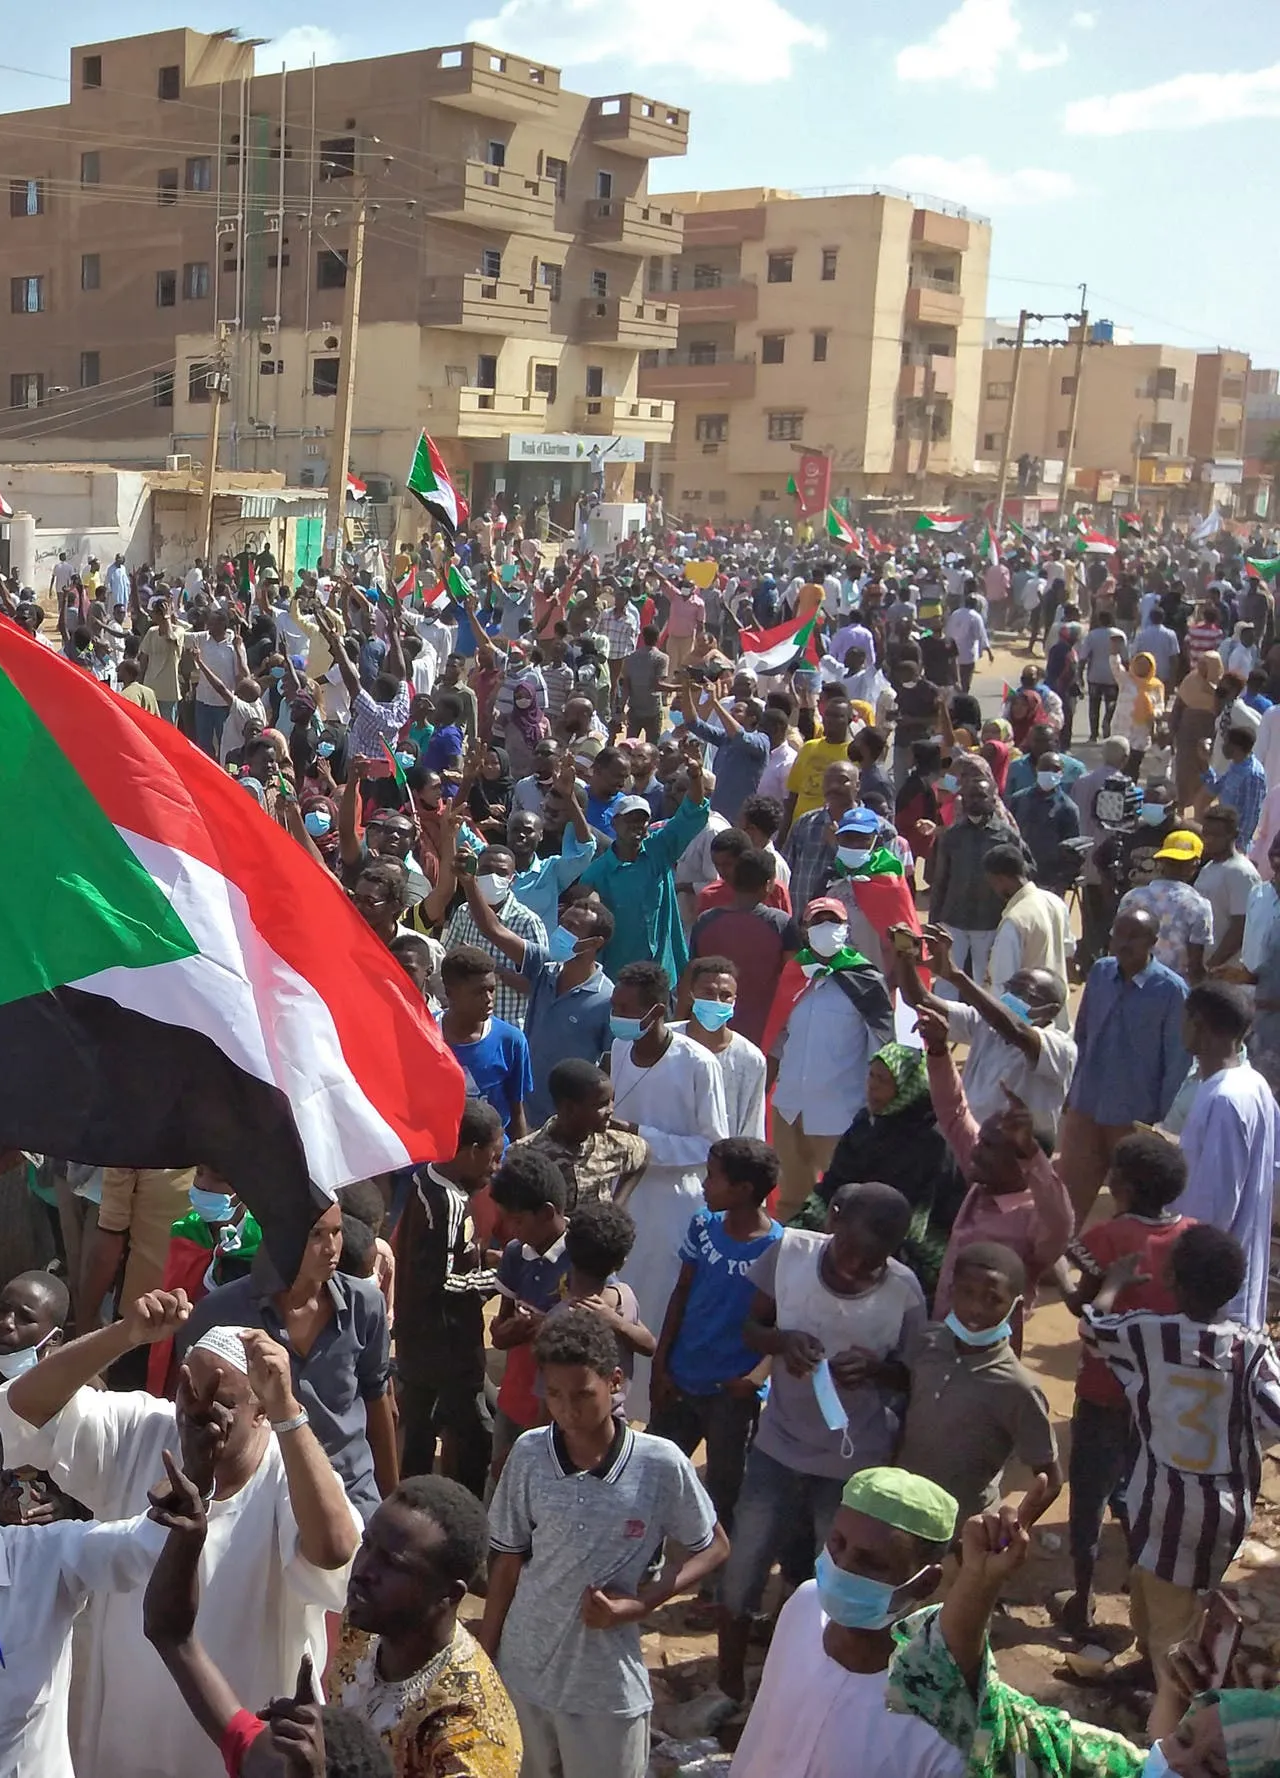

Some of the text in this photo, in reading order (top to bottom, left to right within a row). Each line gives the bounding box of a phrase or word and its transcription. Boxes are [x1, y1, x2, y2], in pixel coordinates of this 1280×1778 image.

[698, 1230, 759, 1276] NEW YO
[1167, 1375, 1223, 1471] 3
